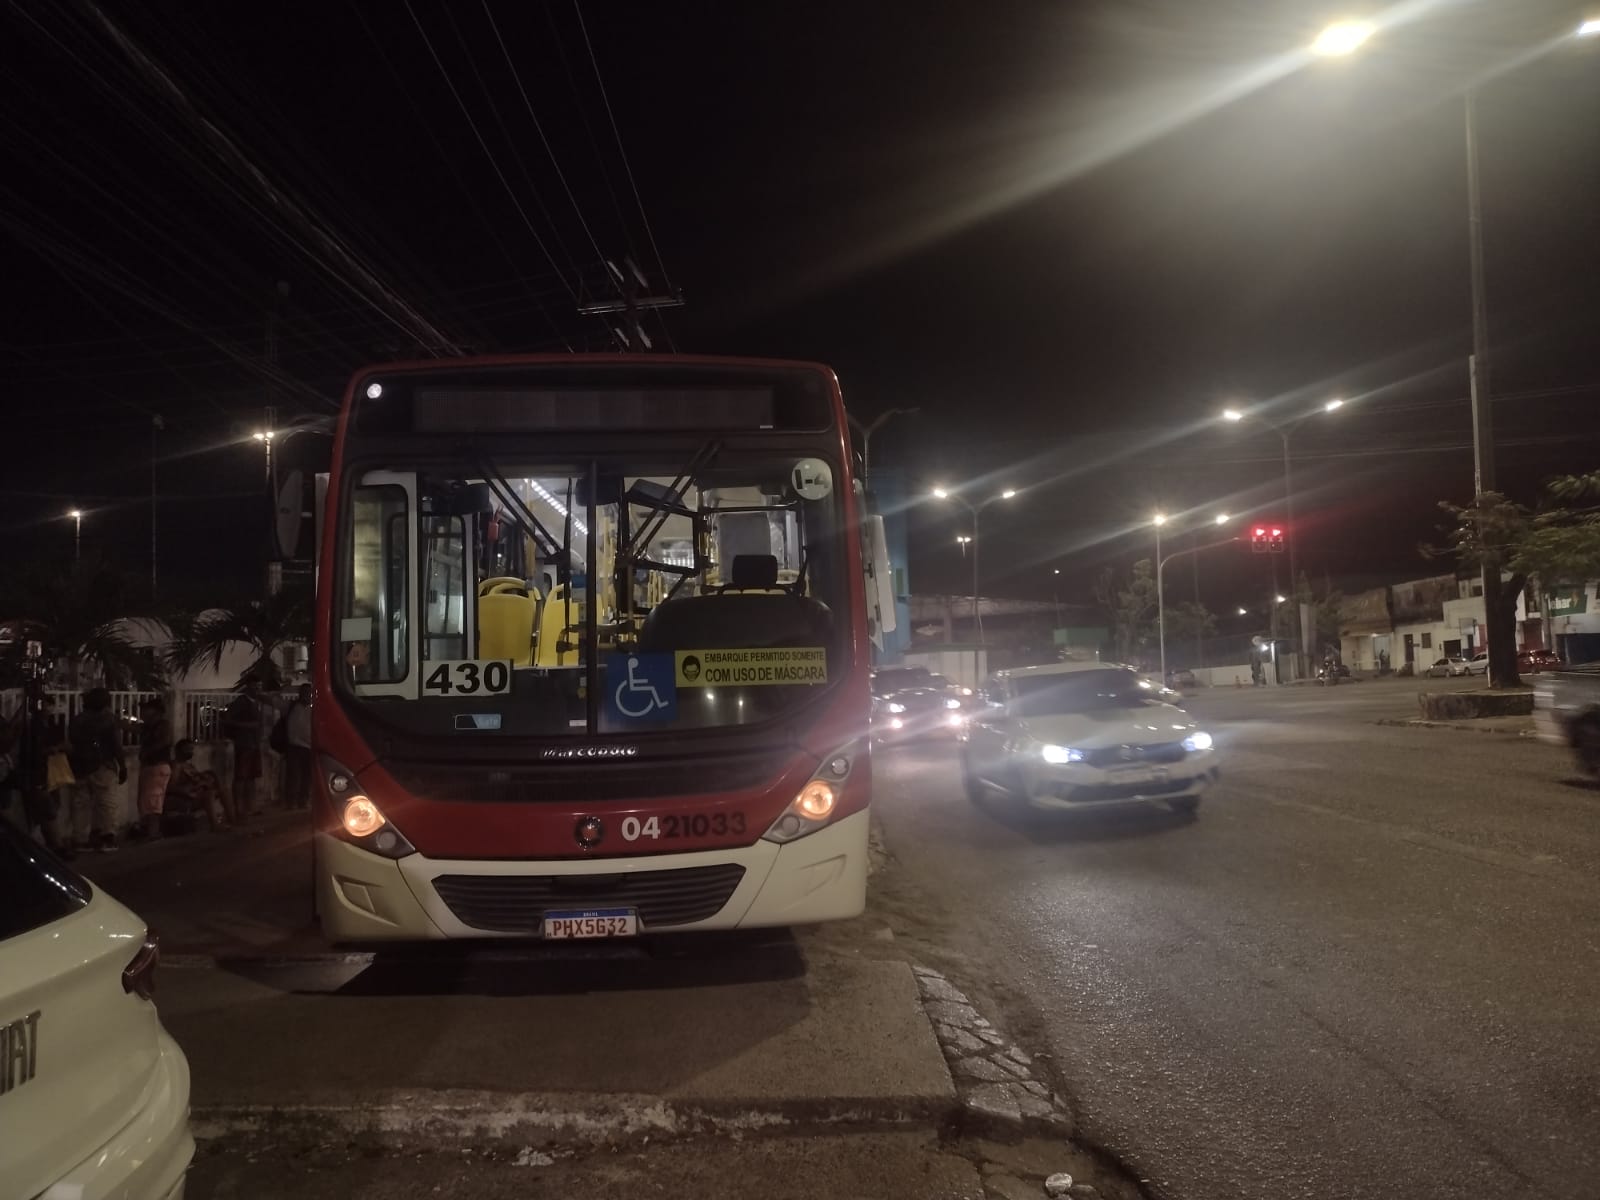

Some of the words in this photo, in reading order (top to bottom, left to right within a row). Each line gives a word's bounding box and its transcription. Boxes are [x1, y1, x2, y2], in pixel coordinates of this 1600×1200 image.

[704, 652, 748, 663] EMBARQUE
[750, 651, 791, 662] PERMITIDO
[792, 650, 825, 661] SOMENTE
[425, 662, 508, 694] 430
[705, 668, 730, 682] COM
[733, 667, 756, 681] USO
[758, 666, 773, 681] DE
[774, 664, 825, 681] MÁSCARA
[552, 918, 627, 937] PHX5G32
